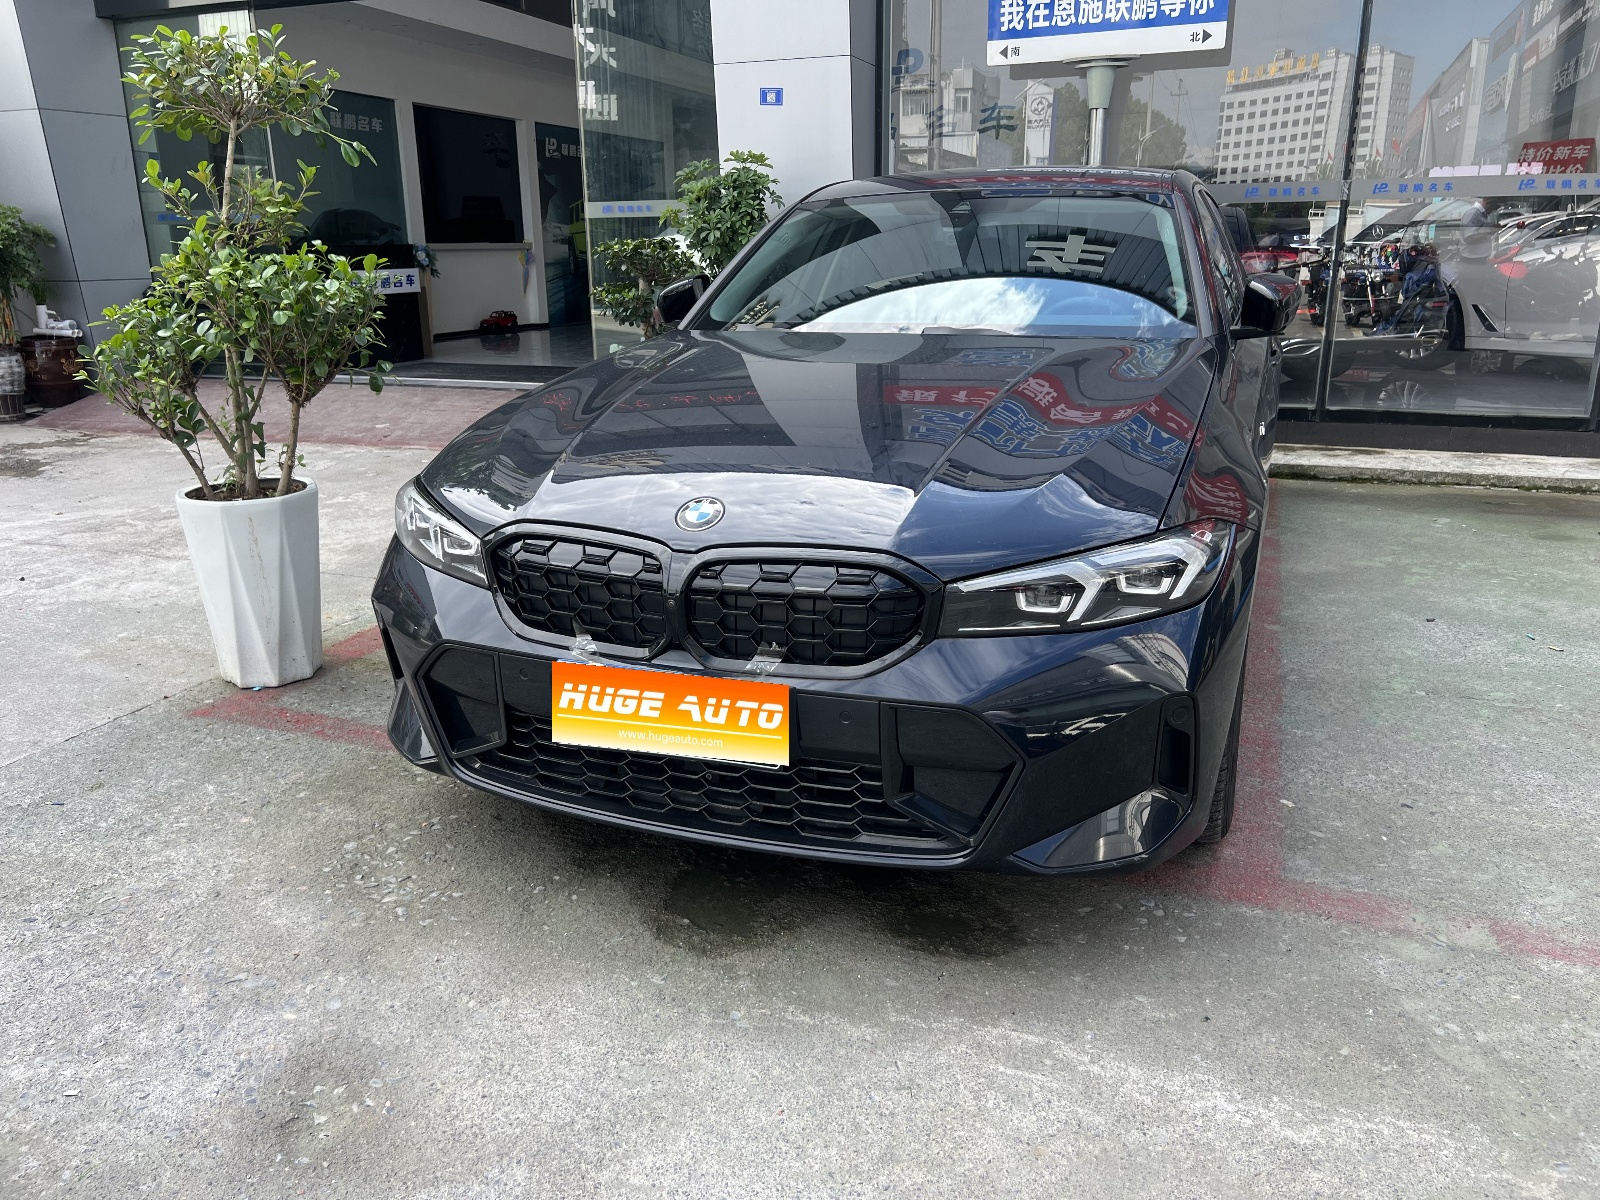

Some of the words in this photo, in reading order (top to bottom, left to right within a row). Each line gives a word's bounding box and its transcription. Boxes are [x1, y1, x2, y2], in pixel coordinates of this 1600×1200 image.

[1190, 31, 1201, 42] 北
[1010, 46, 1021, 57] 南
[330, 112, 383, 133] 联鹏名车
[1519, 145, 1590, 162] 特价新车
[1398, 182, 1453, 193] 联鹏名车
